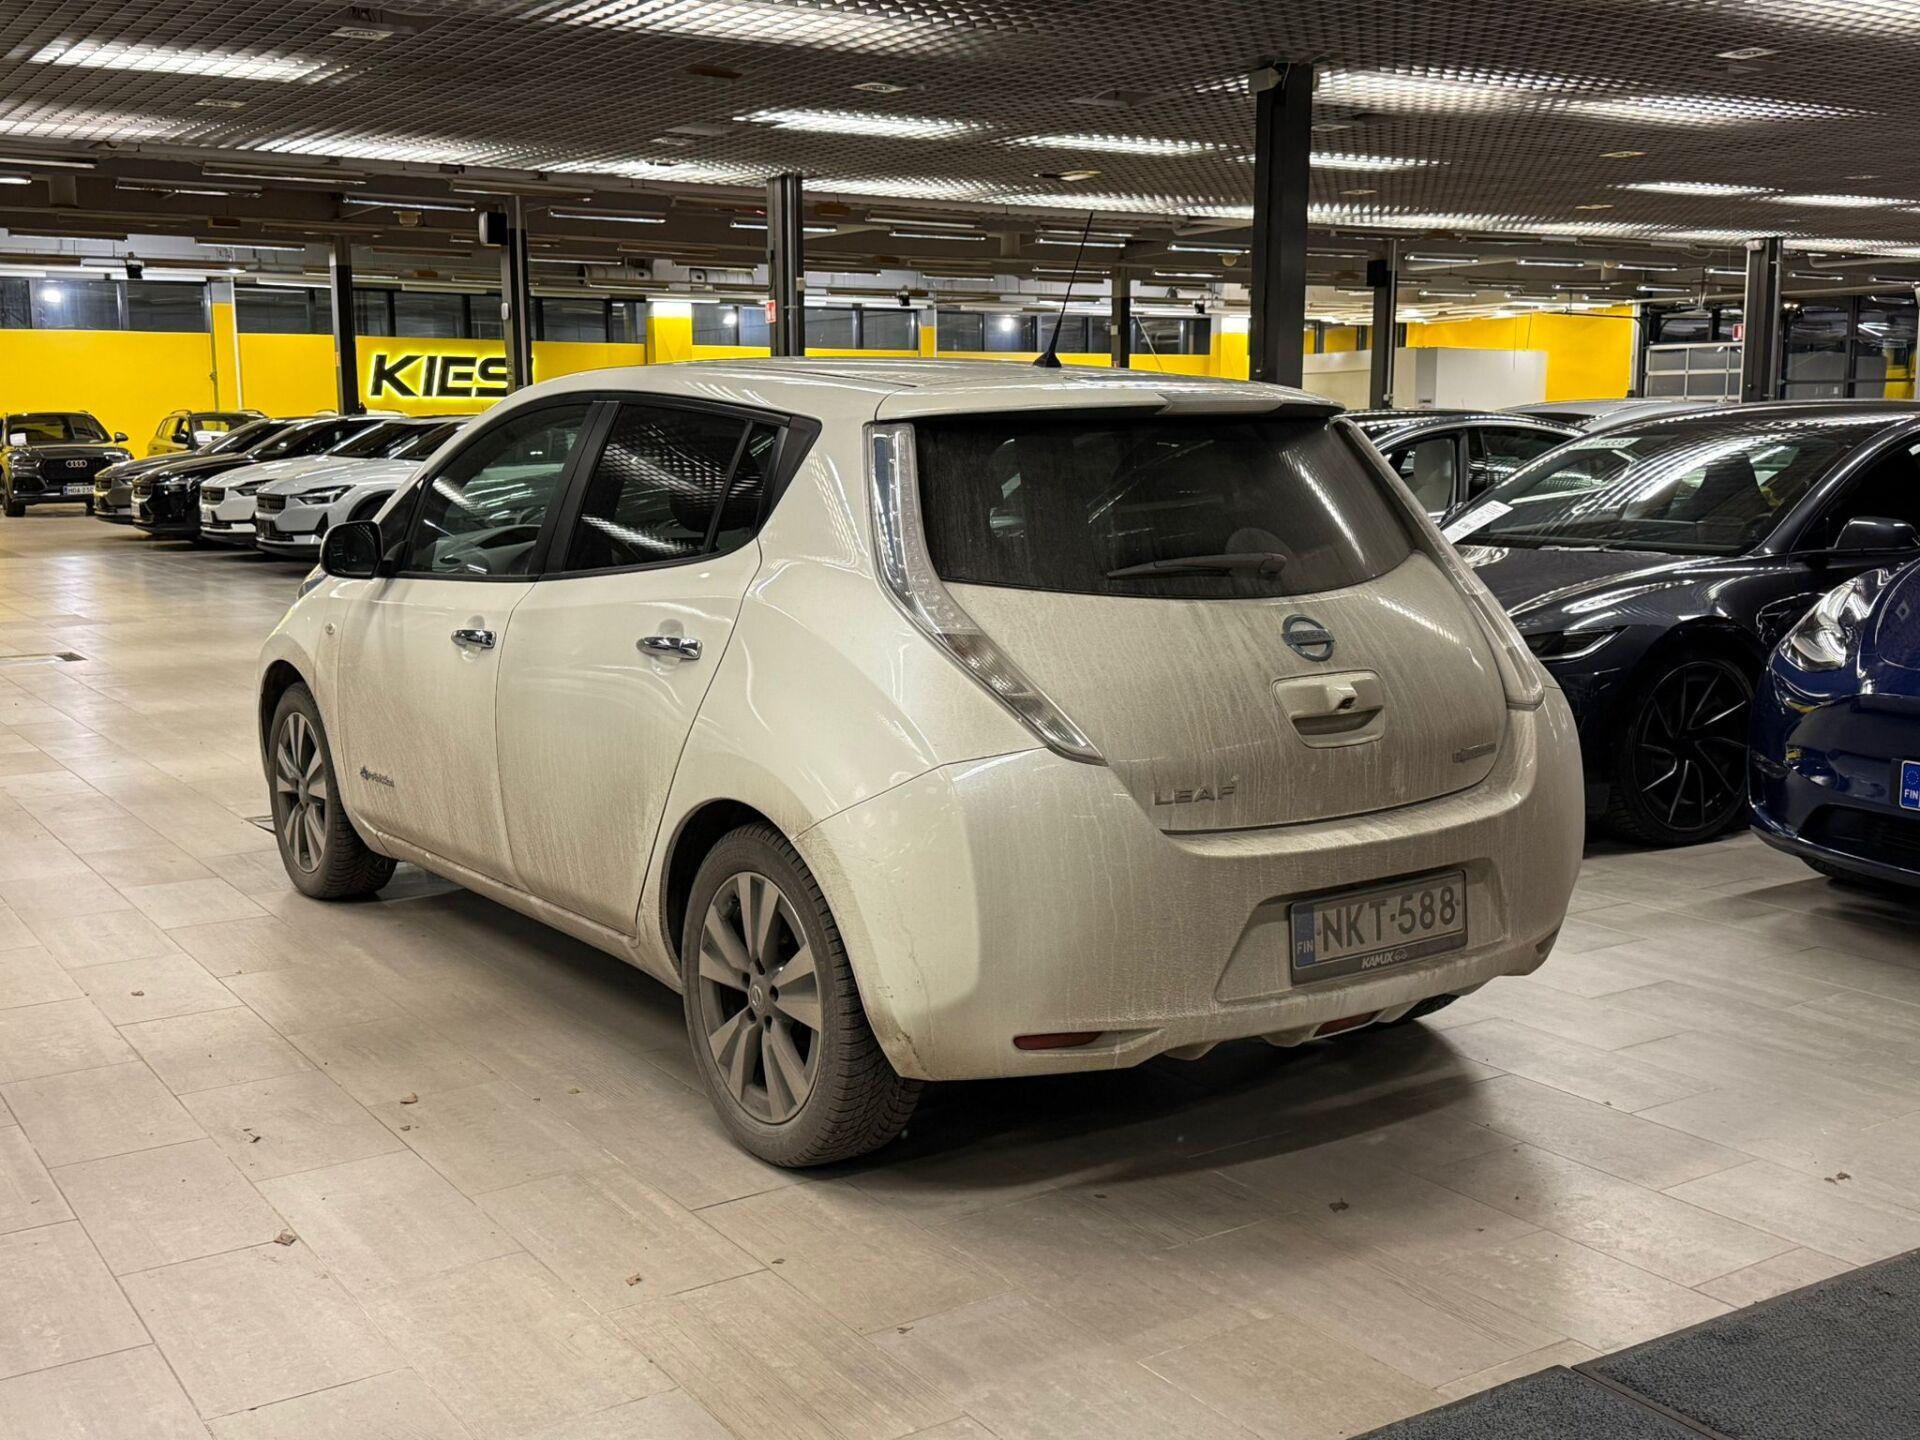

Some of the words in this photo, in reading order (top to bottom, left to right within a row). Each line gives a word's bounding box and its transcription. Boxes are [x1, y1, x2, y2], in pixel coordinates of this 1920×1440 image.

[370, 354, 534, 397] KIES
[1152, 784, 1236, 806] LEAF
[1904, 788, 1919, 800] FIN
[1297, 940, 1314, 955] FIN
[1322, 886, 1456, 951] NKT-588
